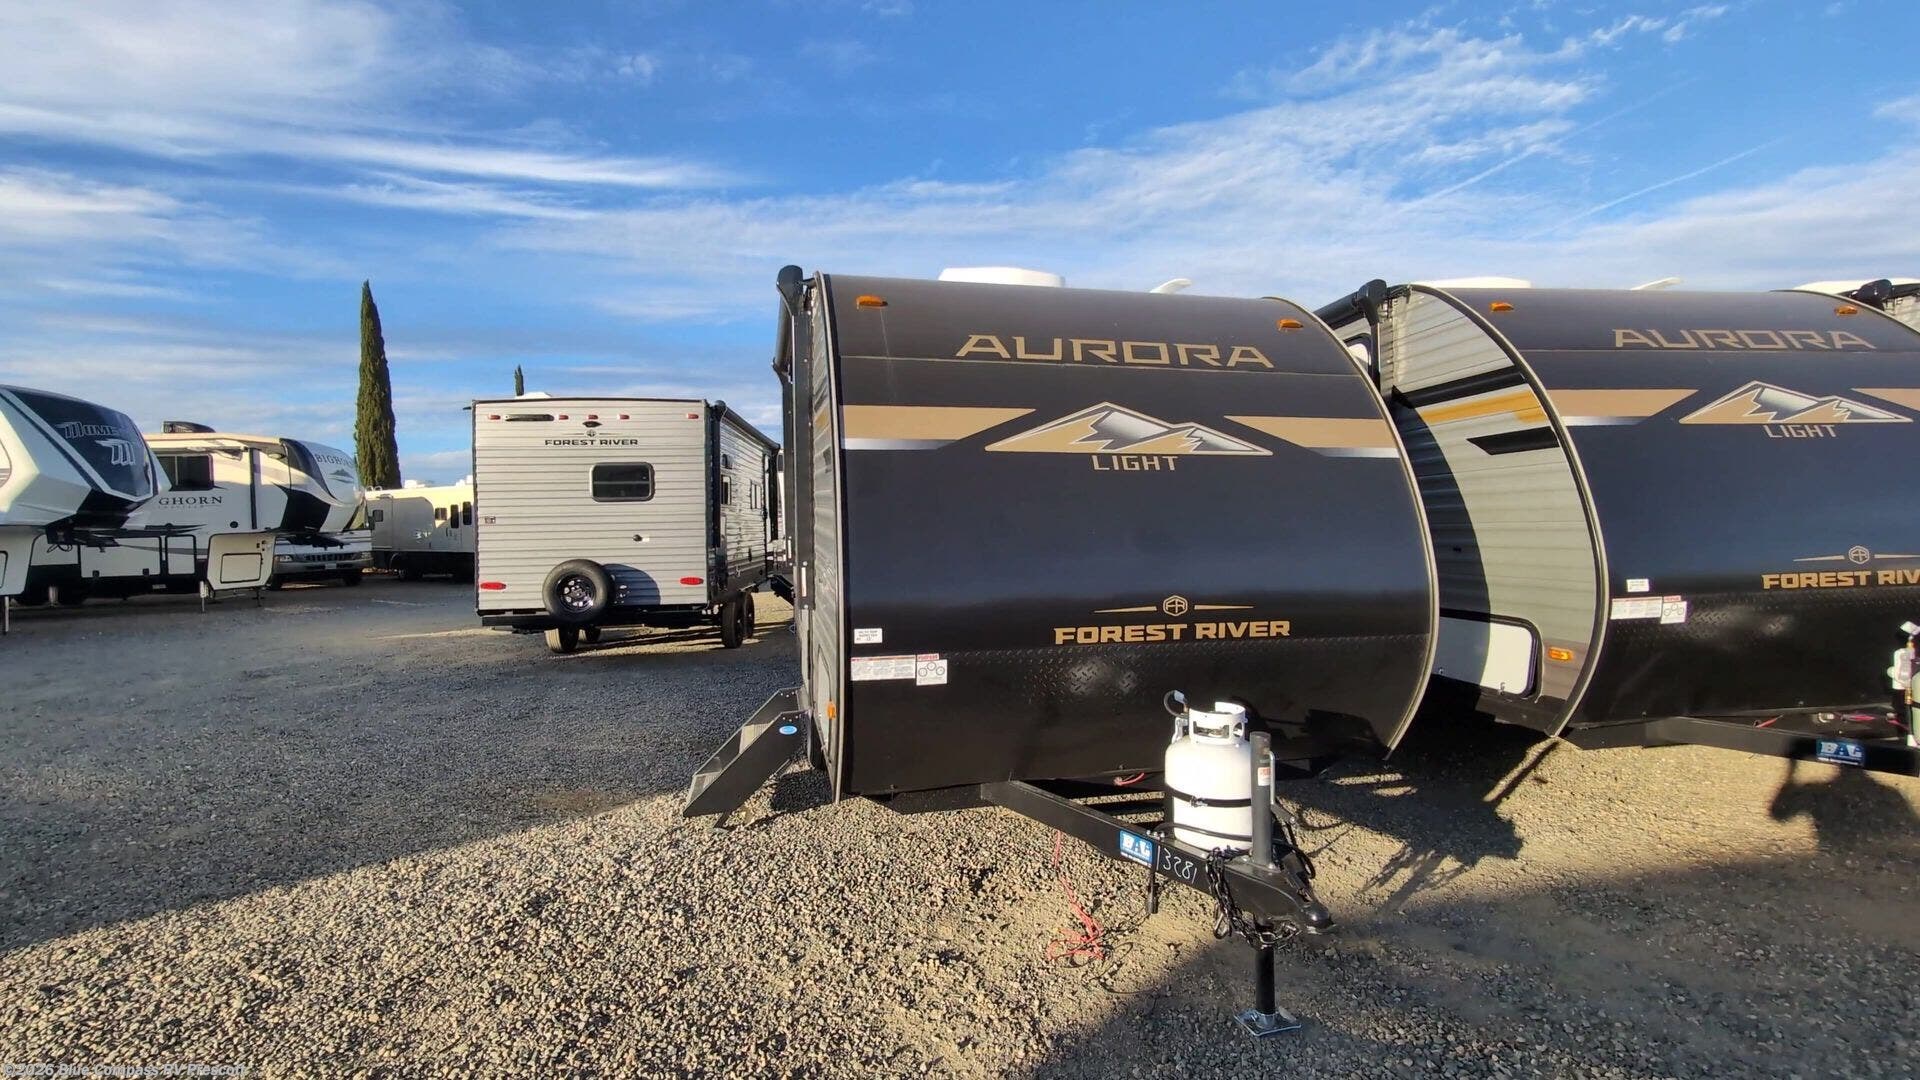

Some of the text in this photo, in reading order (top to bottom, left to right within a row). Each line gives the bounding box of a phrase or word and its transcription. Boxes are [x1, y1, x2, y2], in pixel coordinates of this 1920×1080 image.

[1612, 328, 1877, 350] AURORA
[955, 334, 1275, 369] AURORA
[1762, 424, 1839, 440] LIGHT
[1091, 453, 1179, 472] LIGHT
[1762, 571, 1872, 590] FOREST
[1054, 620, 1291, 645] FOREST RIVER
